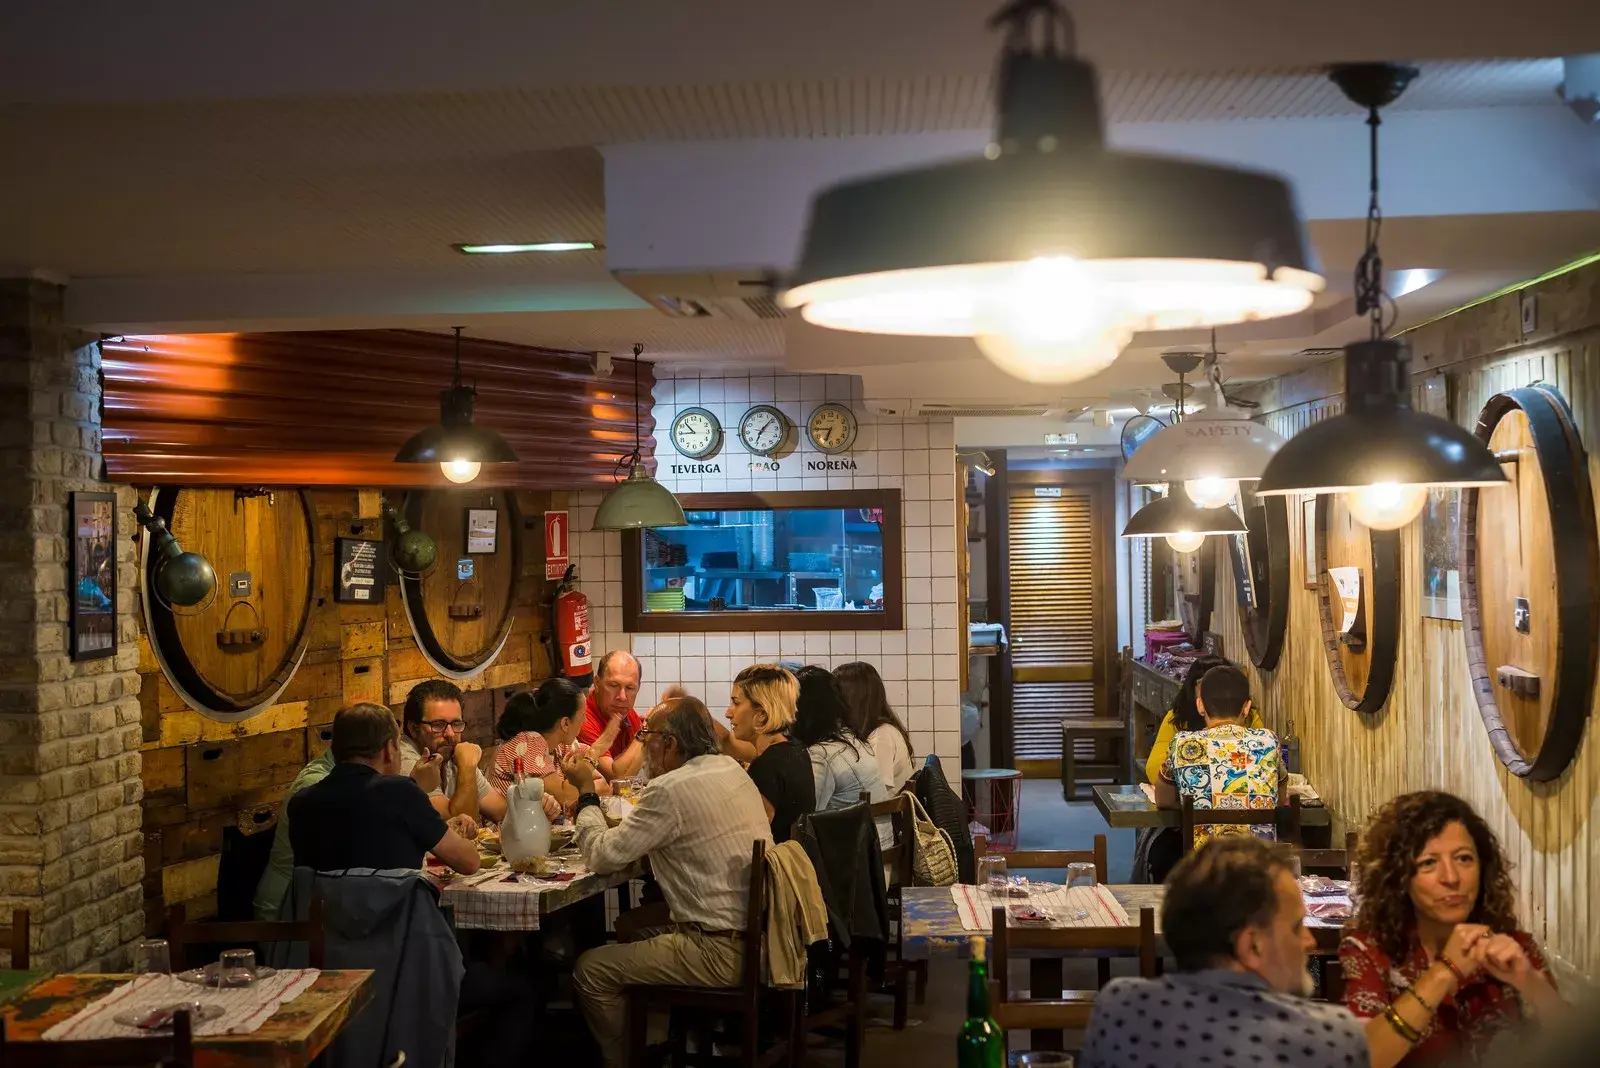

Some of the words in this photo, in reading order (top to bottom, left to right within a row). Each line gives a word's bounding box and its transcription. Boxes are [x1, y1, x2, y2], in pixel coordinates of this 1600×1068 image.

[1184, 424, 1252, 437] SAFETY
[671, 464, 721, 474] TEVERGA
[807, 458, 857, 471] NOREÑA
